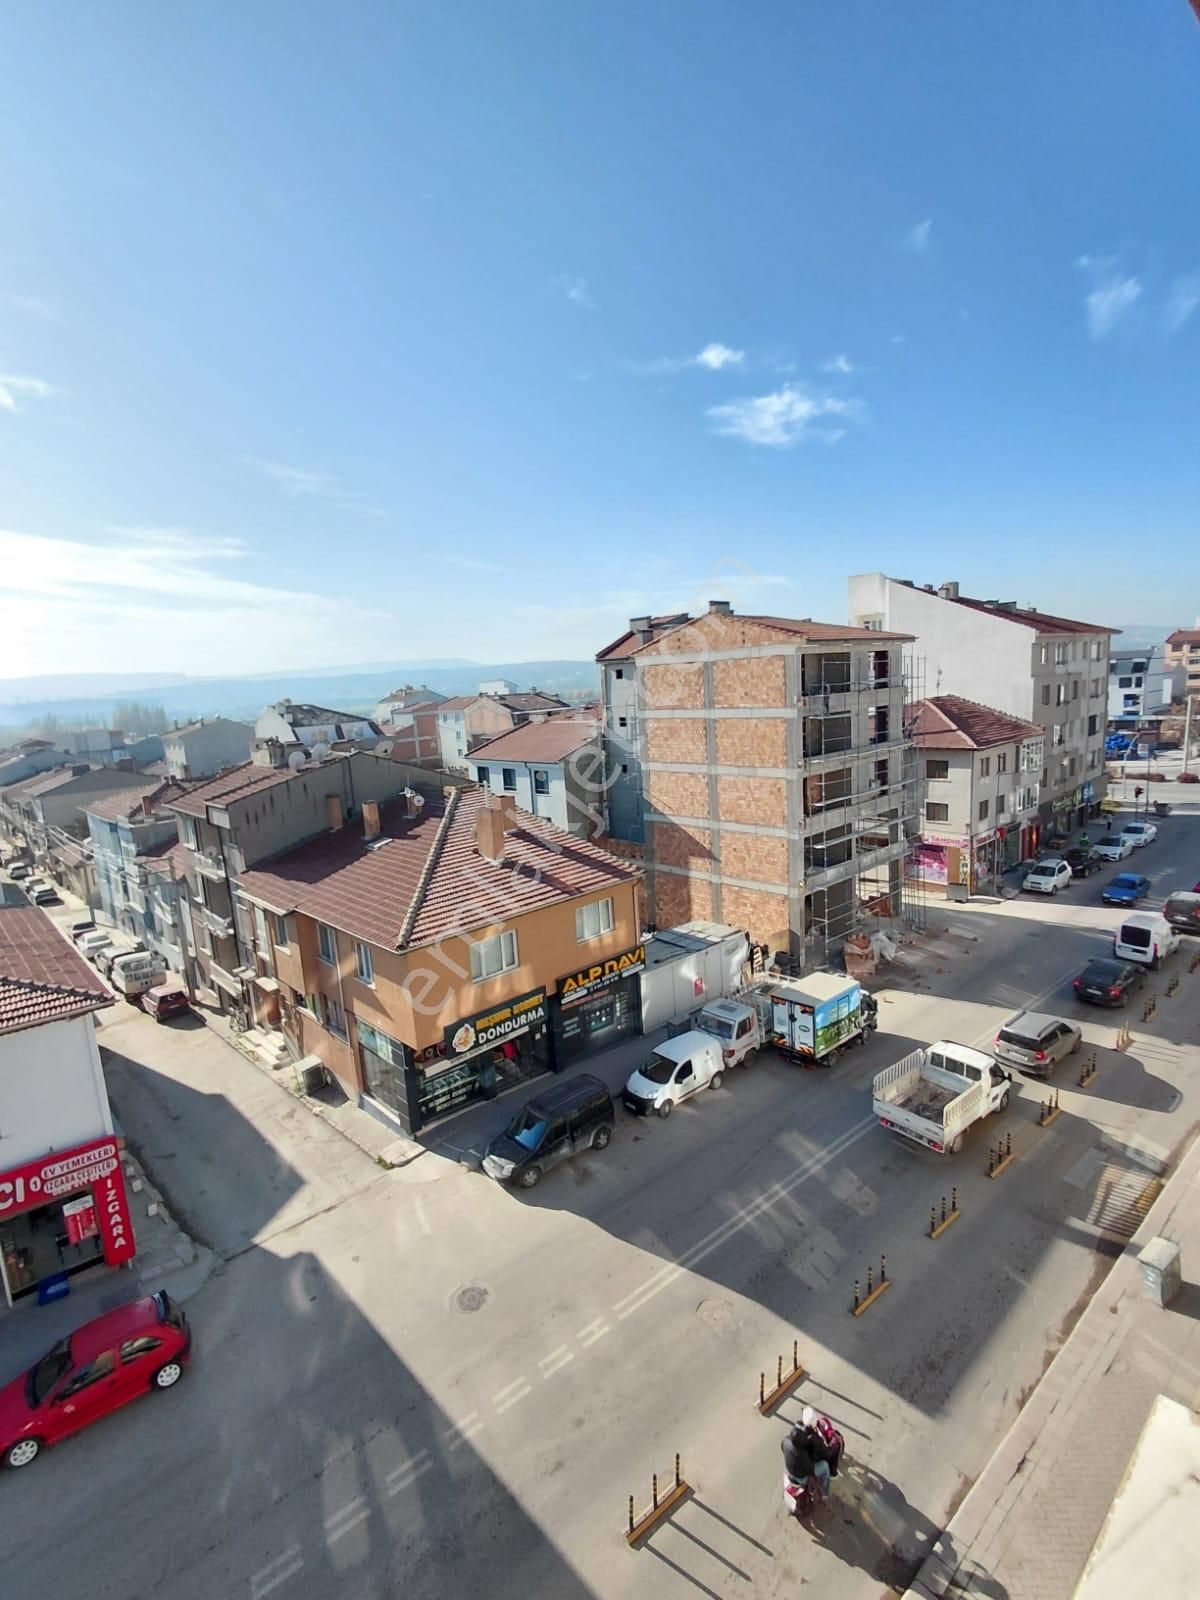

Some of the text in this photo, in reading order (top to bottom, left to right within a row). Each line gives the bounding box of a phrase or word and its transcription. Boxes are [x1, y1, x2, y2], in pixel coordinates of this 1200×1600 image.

[561, 967, 602, 993] ALP
[477, 1005, 546, 1045] DONDURMA
[43, 1147, 114, 1178] EV YEMEKLERİ
[46, 1174, 76, 1190] IZGARA
[106, 1178, 127, 1249] IZGARA
